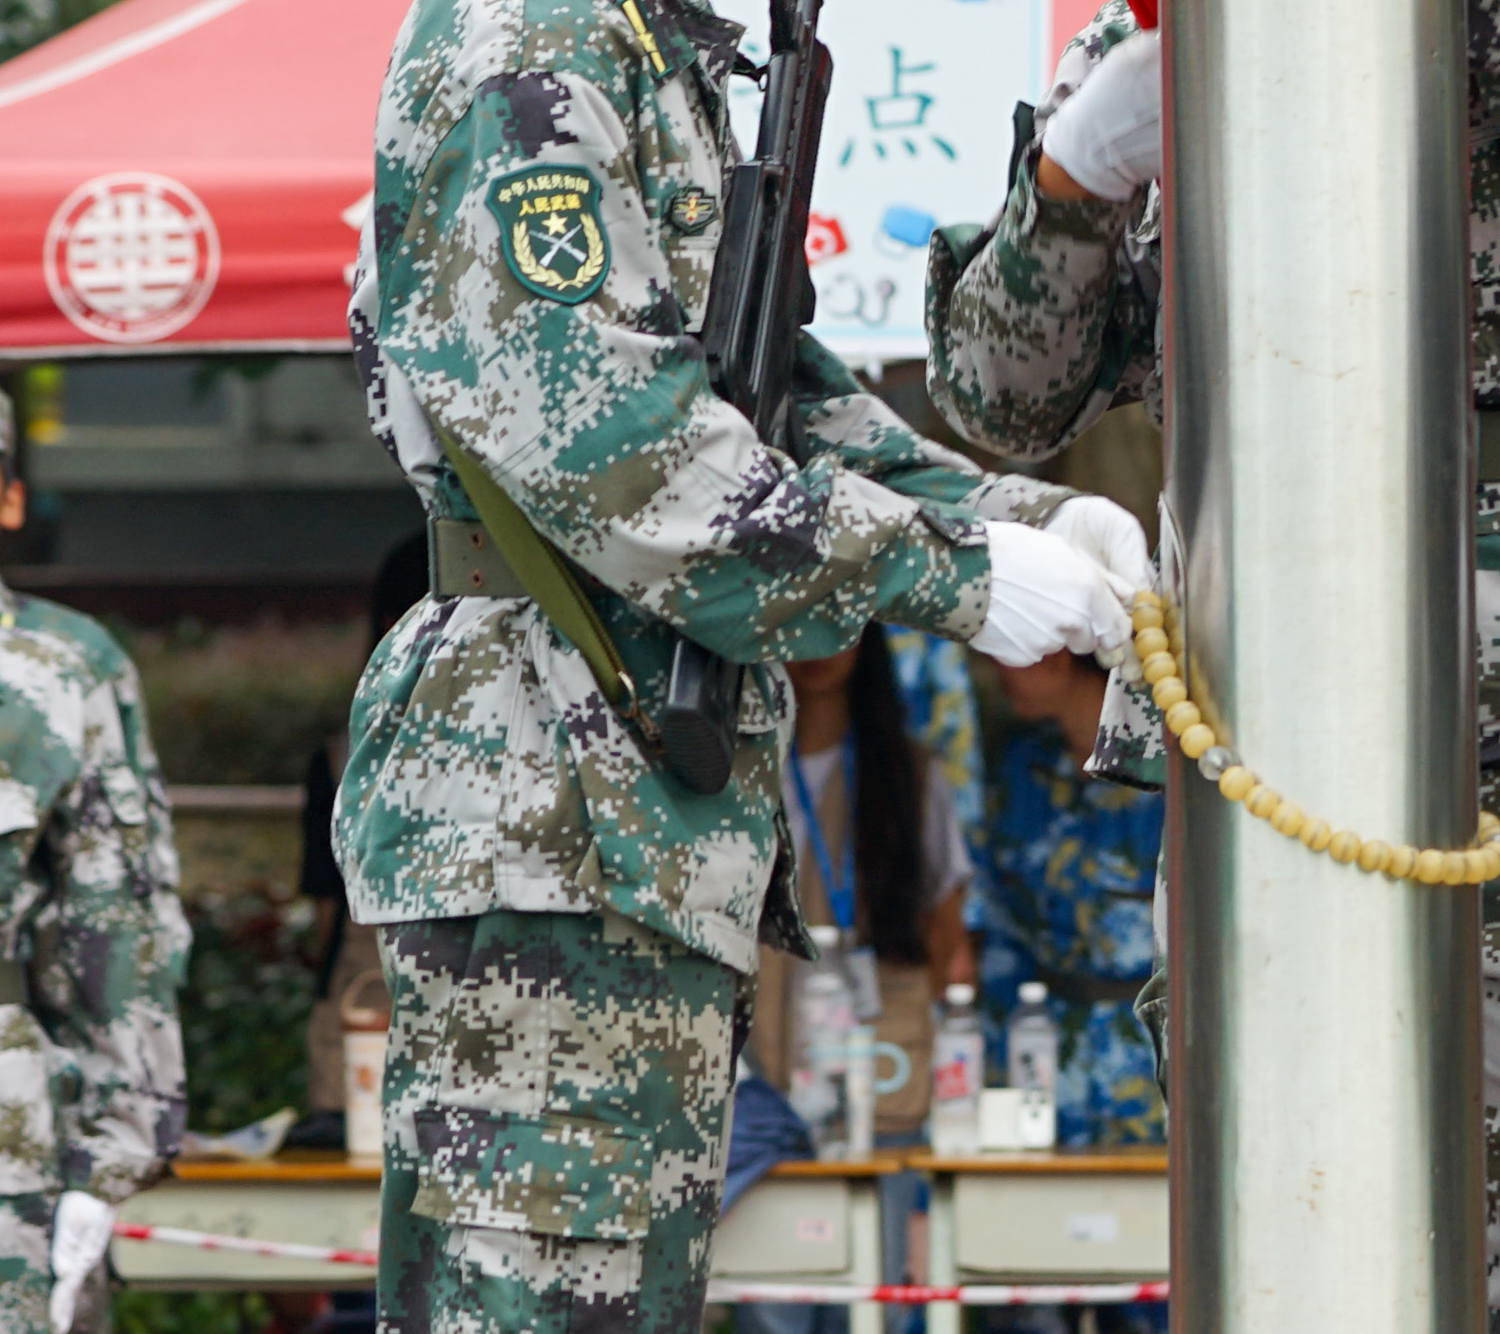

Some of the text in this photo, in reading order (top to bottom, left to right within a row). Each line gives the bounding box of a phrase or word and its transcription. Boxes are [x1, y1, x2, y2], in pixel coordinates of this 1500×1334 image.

[498, 173, 591, 204] 中华人民共和国
